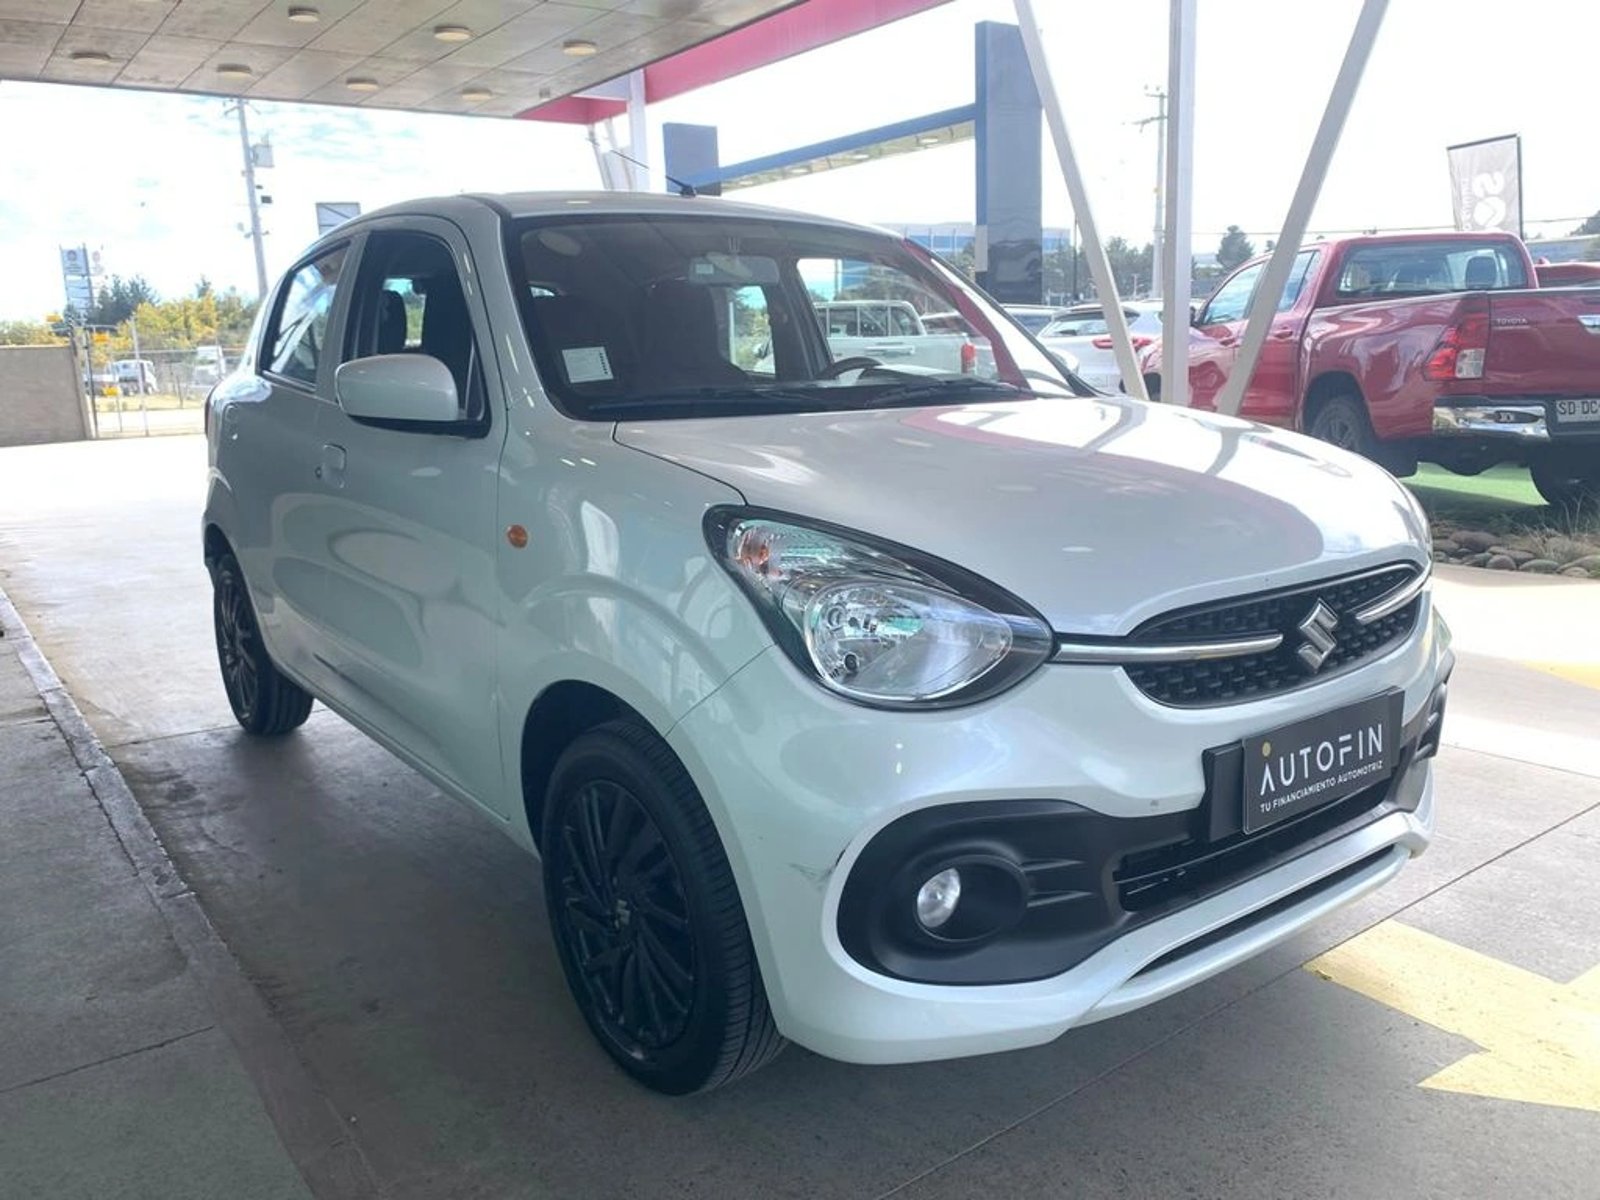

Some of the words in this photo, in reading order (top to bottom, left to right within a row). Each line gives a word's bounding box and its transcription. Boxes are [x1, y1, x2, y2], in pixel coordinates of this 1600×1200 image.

[1496, 318, 1528, 326] TOYOTA
[1260, 723, 1382, 796] AUTOFIN
[1260, 801, 1272, 813] TU
[1273, 776, 1336, 809] FINANCIAMIENTO
[1337, 760, 1383, 784] AUTOMOTRIZ
